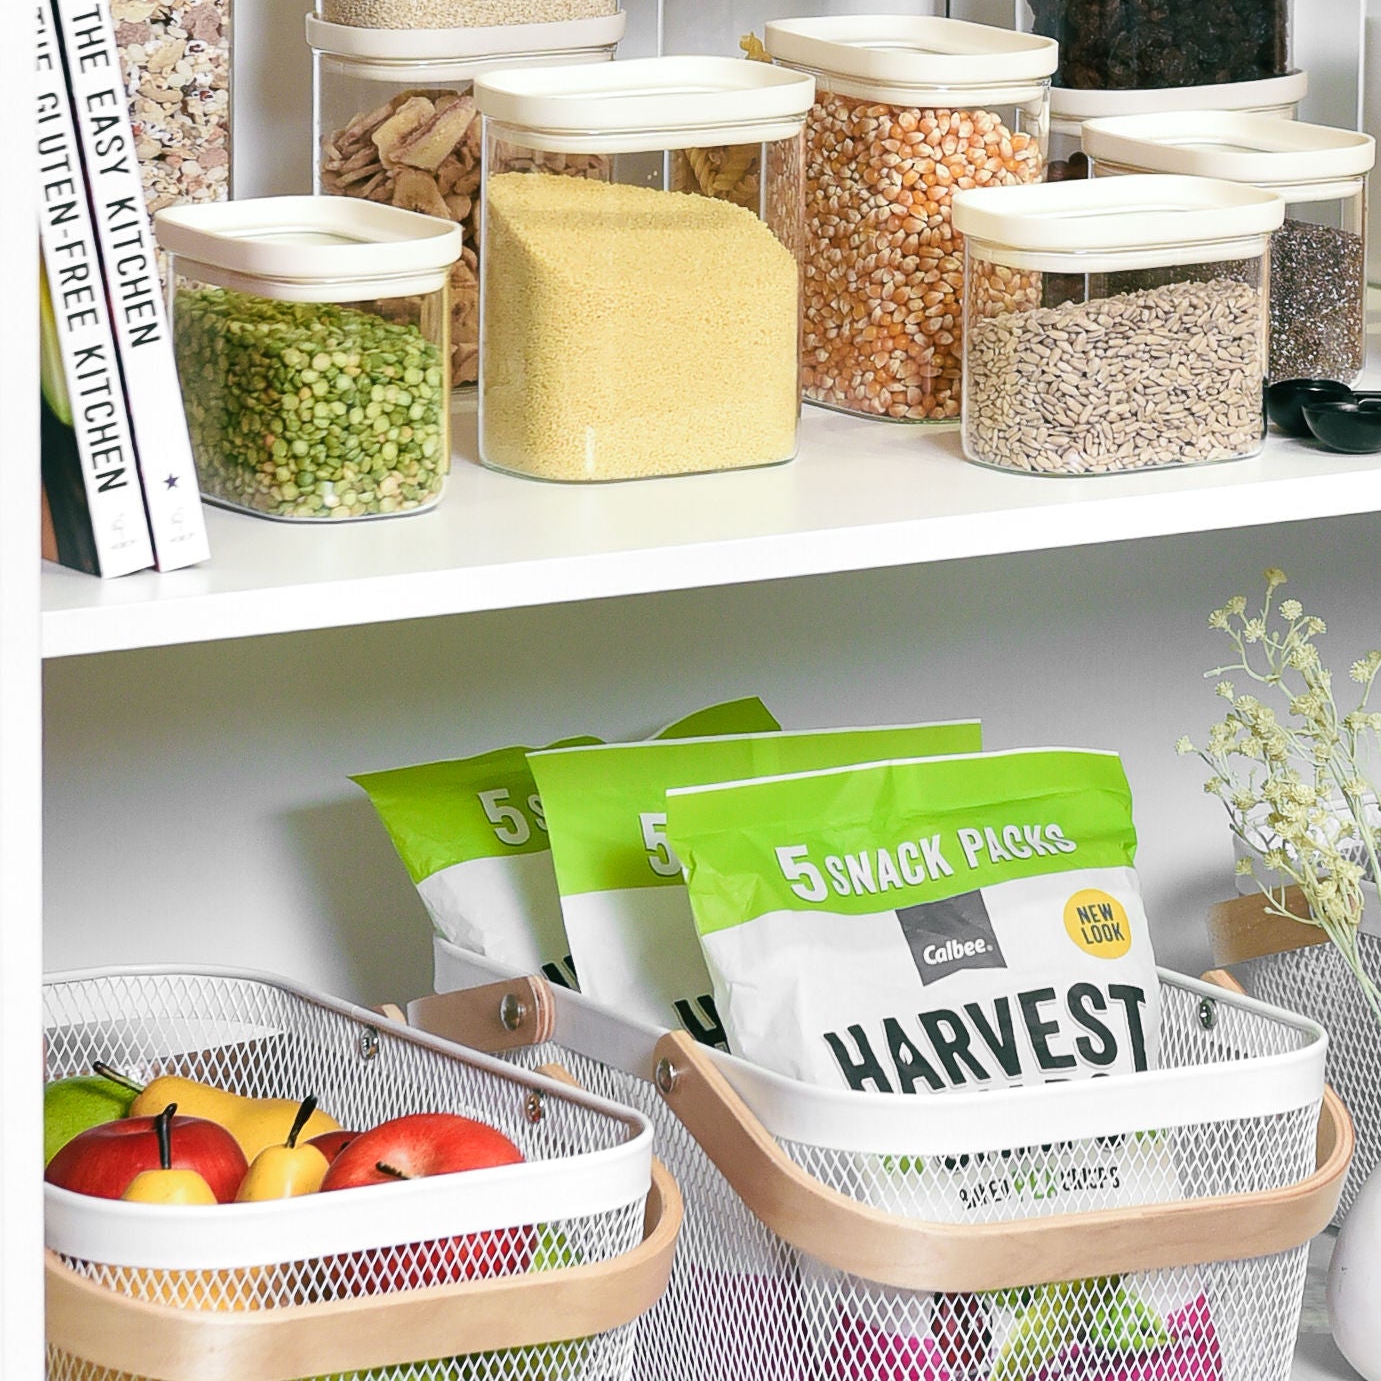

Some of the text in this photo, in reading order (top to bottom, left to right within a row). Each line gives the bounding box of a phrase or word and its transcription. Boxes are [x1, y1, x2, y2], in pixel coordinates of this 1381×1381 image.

[71, 3, 161, 348] THE EASY KITCHEN
[73, 344, 129, 494] KITCHEN
[477, 787, 531, 845] 5
[639, 812, 684, 876] 5
[774, 822, 1078, 902] 5 SNACK PACKS
[1076, 903, 1114, 925] NEW
[1080, 922, 1125, 945] LOOK
[823, 982, 1148, 1095] HARVEST
